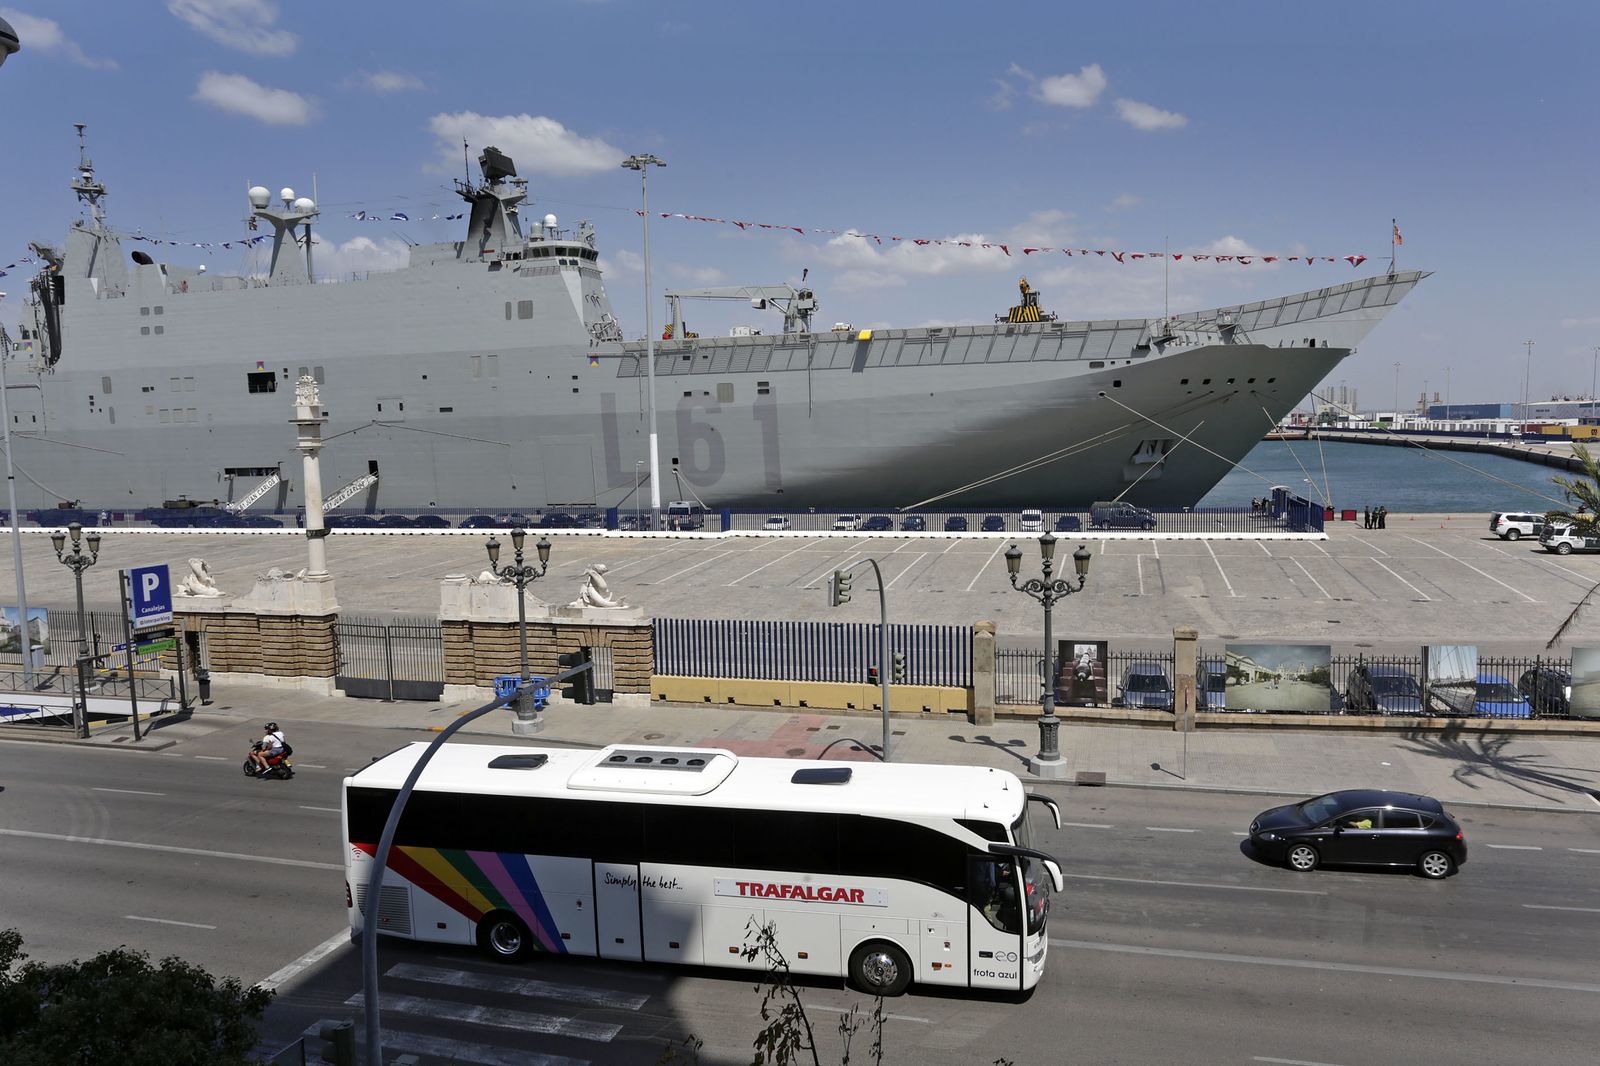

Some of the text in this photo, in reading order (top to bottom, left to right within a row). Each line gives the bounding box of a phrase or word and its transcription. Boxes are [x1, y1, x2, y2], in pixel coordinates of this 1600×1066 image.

[245, 493, 258, 507] JUAN
[257, 478, 276, 496] CARLOS
[142, 572, 160, 602] P
[141, 605, 166, 613] Canalejas
[604, 872, 637, 892] Simply
[642, 875, 656, 888] the
[736, 882, 865, 903] TRAFALGAR
[974, 969, 1017, 980] frota azul
